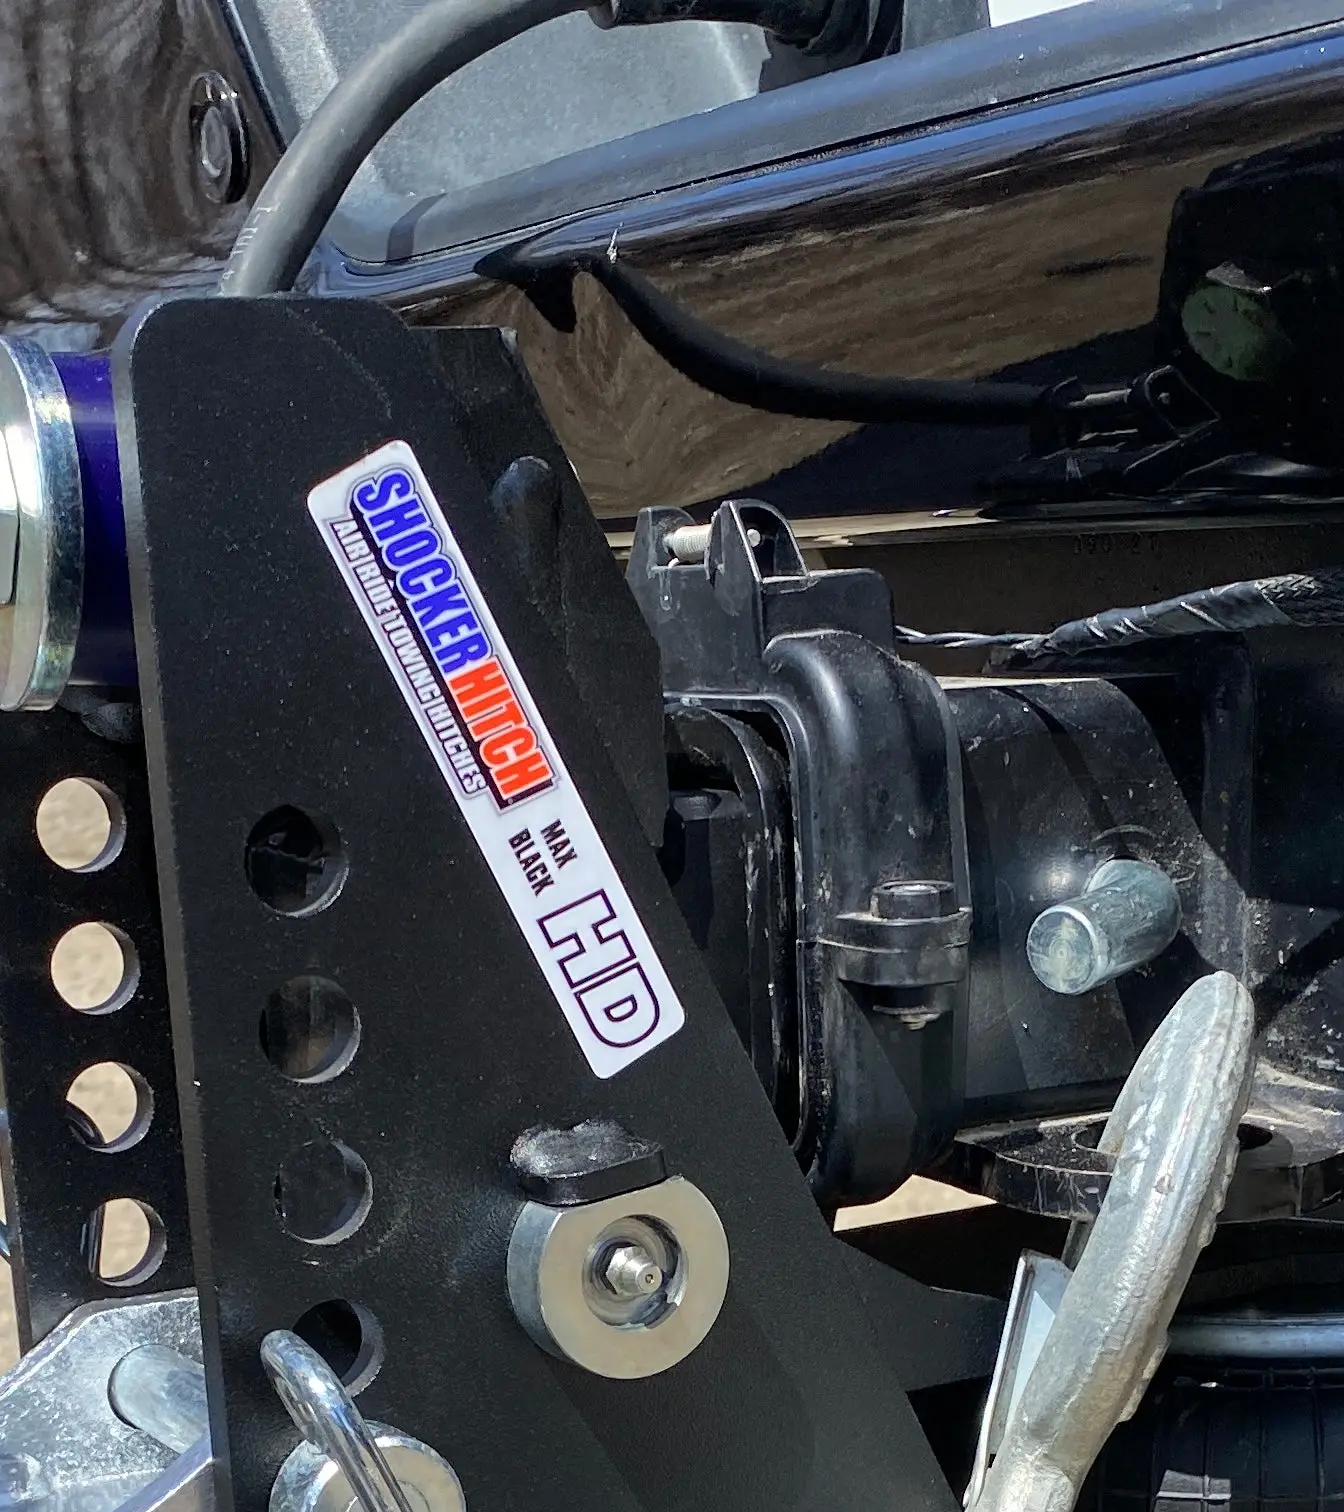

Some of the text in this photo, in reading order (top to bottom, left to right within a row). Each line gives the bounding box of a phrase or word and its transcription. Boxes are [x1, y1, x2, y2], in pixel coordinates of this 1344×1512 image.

[330, 519, 488, 794] AIR RIDE TOWING HITCHES
[508, 828, 555, 897] BLACK
[540, 819, 578, 870] MAX
[536, 888, 661, 1049] HD
